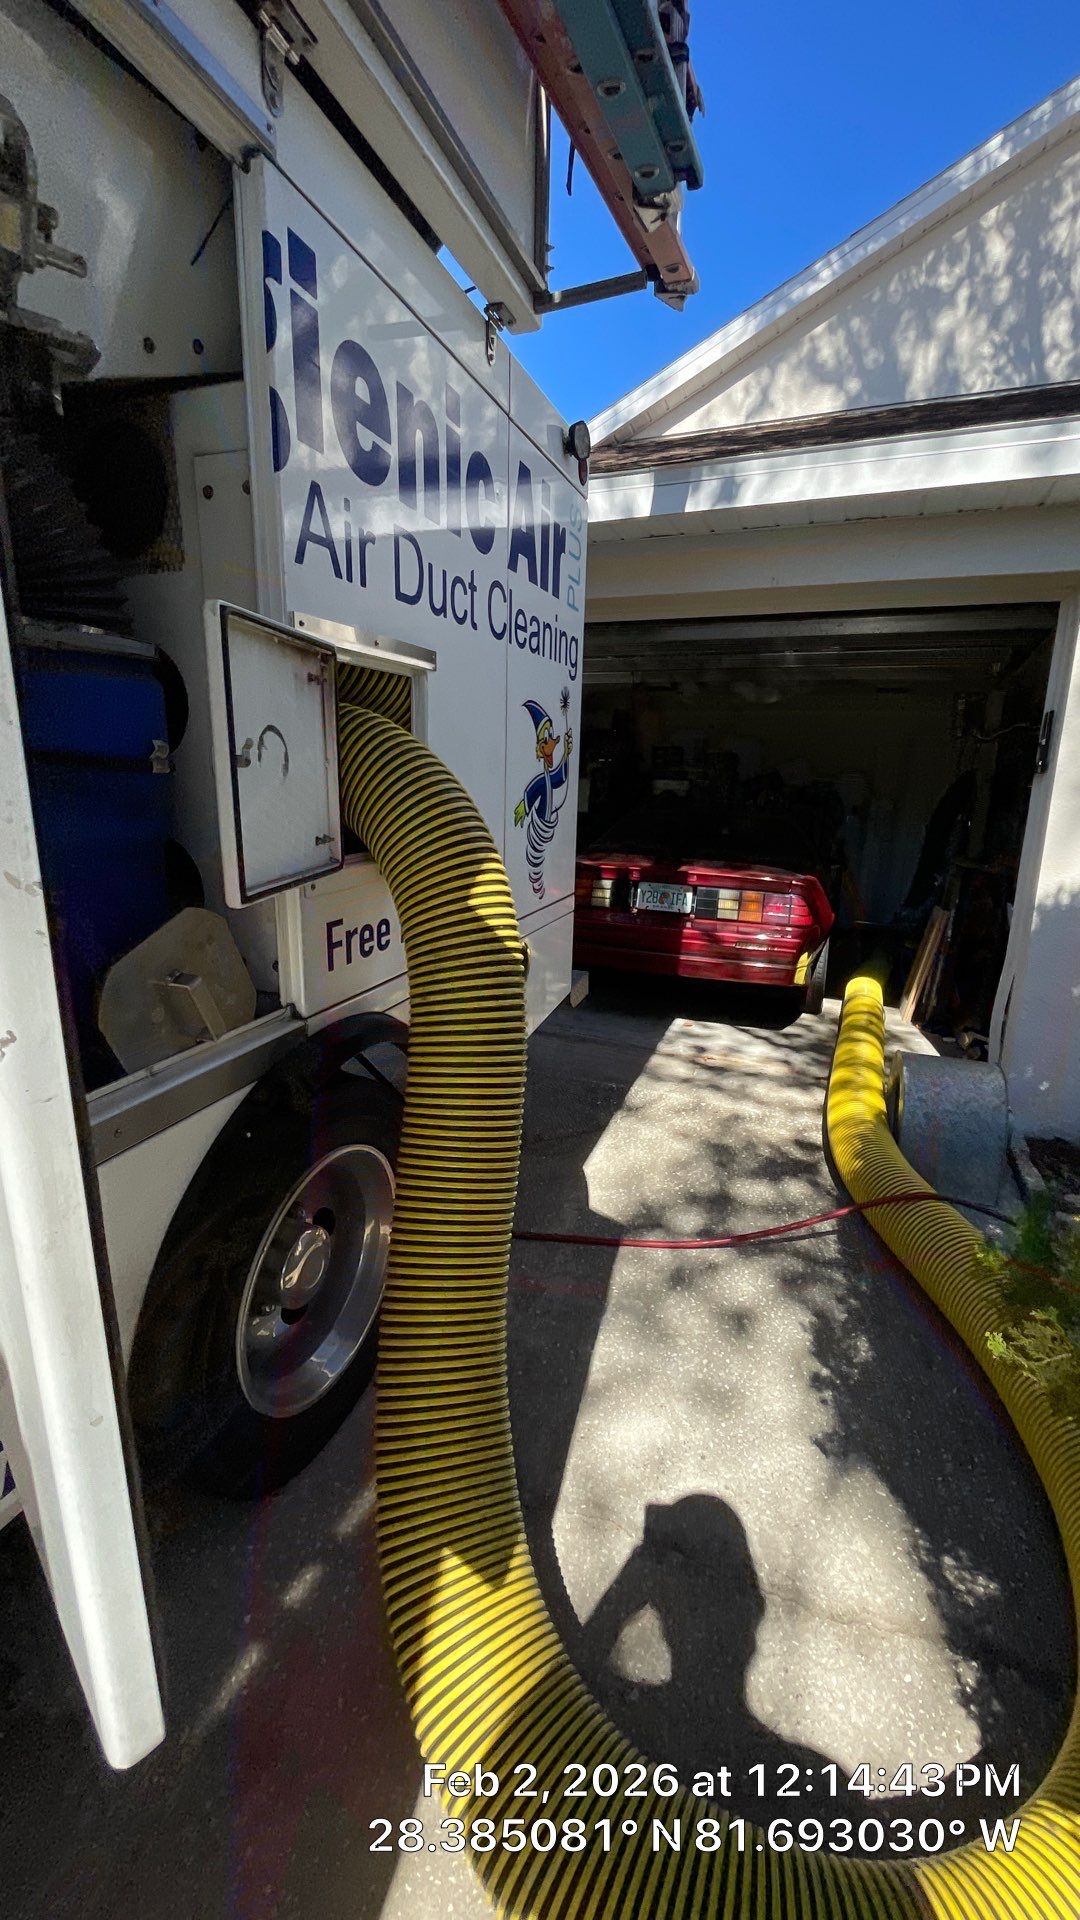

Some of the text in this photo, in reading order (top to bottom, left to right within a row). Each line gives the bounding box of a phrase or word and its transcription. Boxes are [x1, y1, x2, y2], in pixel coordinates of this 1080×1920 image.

[294, 480, 579, 681] Air Duct Cleaning
[507, 460, 567, 599] Air
[567, 503, 583, 612] PLUS
[326, 918, 391, 972] Free
